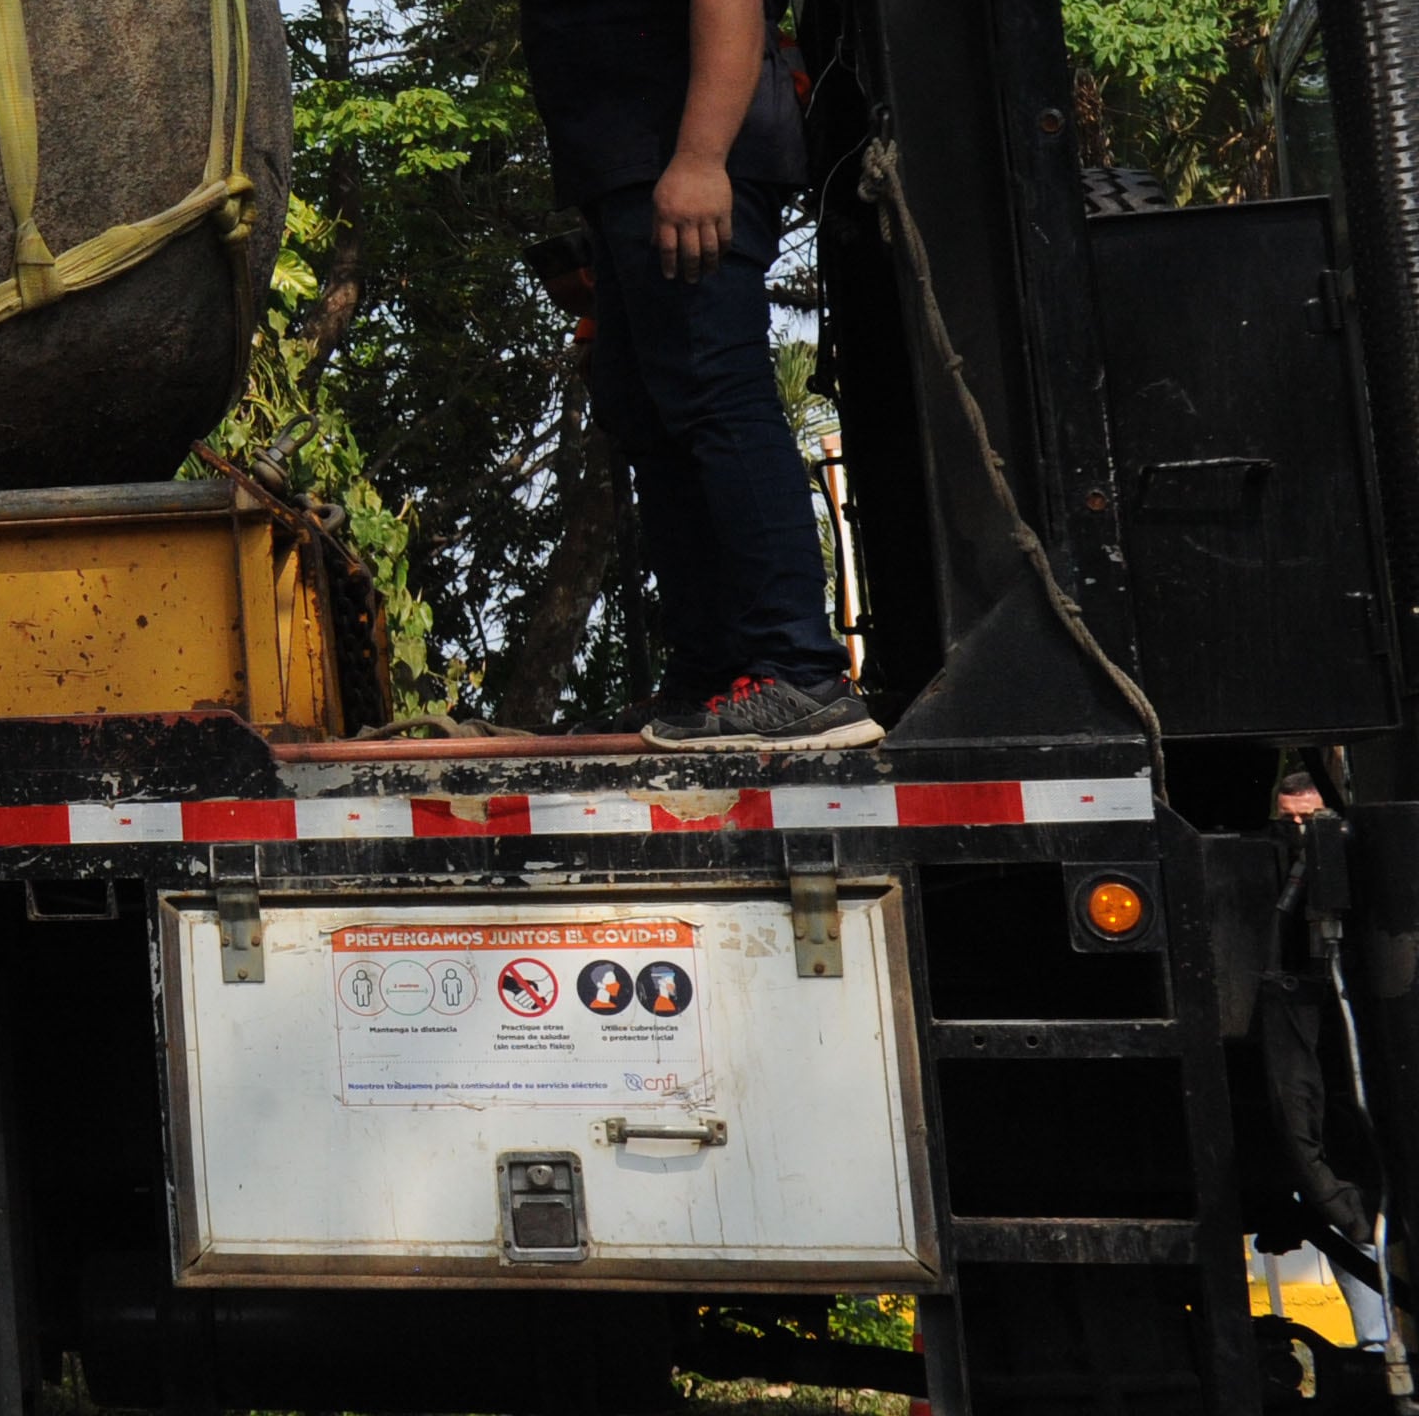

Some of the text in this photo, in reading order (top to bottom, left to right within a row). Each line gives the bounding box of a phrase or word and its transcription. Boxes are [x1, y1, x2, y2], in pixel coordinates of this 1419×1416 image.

[344, 928, 677, 947] PREVENGAMOS JUNTOS EL COVID-19
[369, 1026, 409, 1034] Mantenga
[501, 1024, 540, 1032] Practique
[644, 1073, 679, 1091] cnfl
